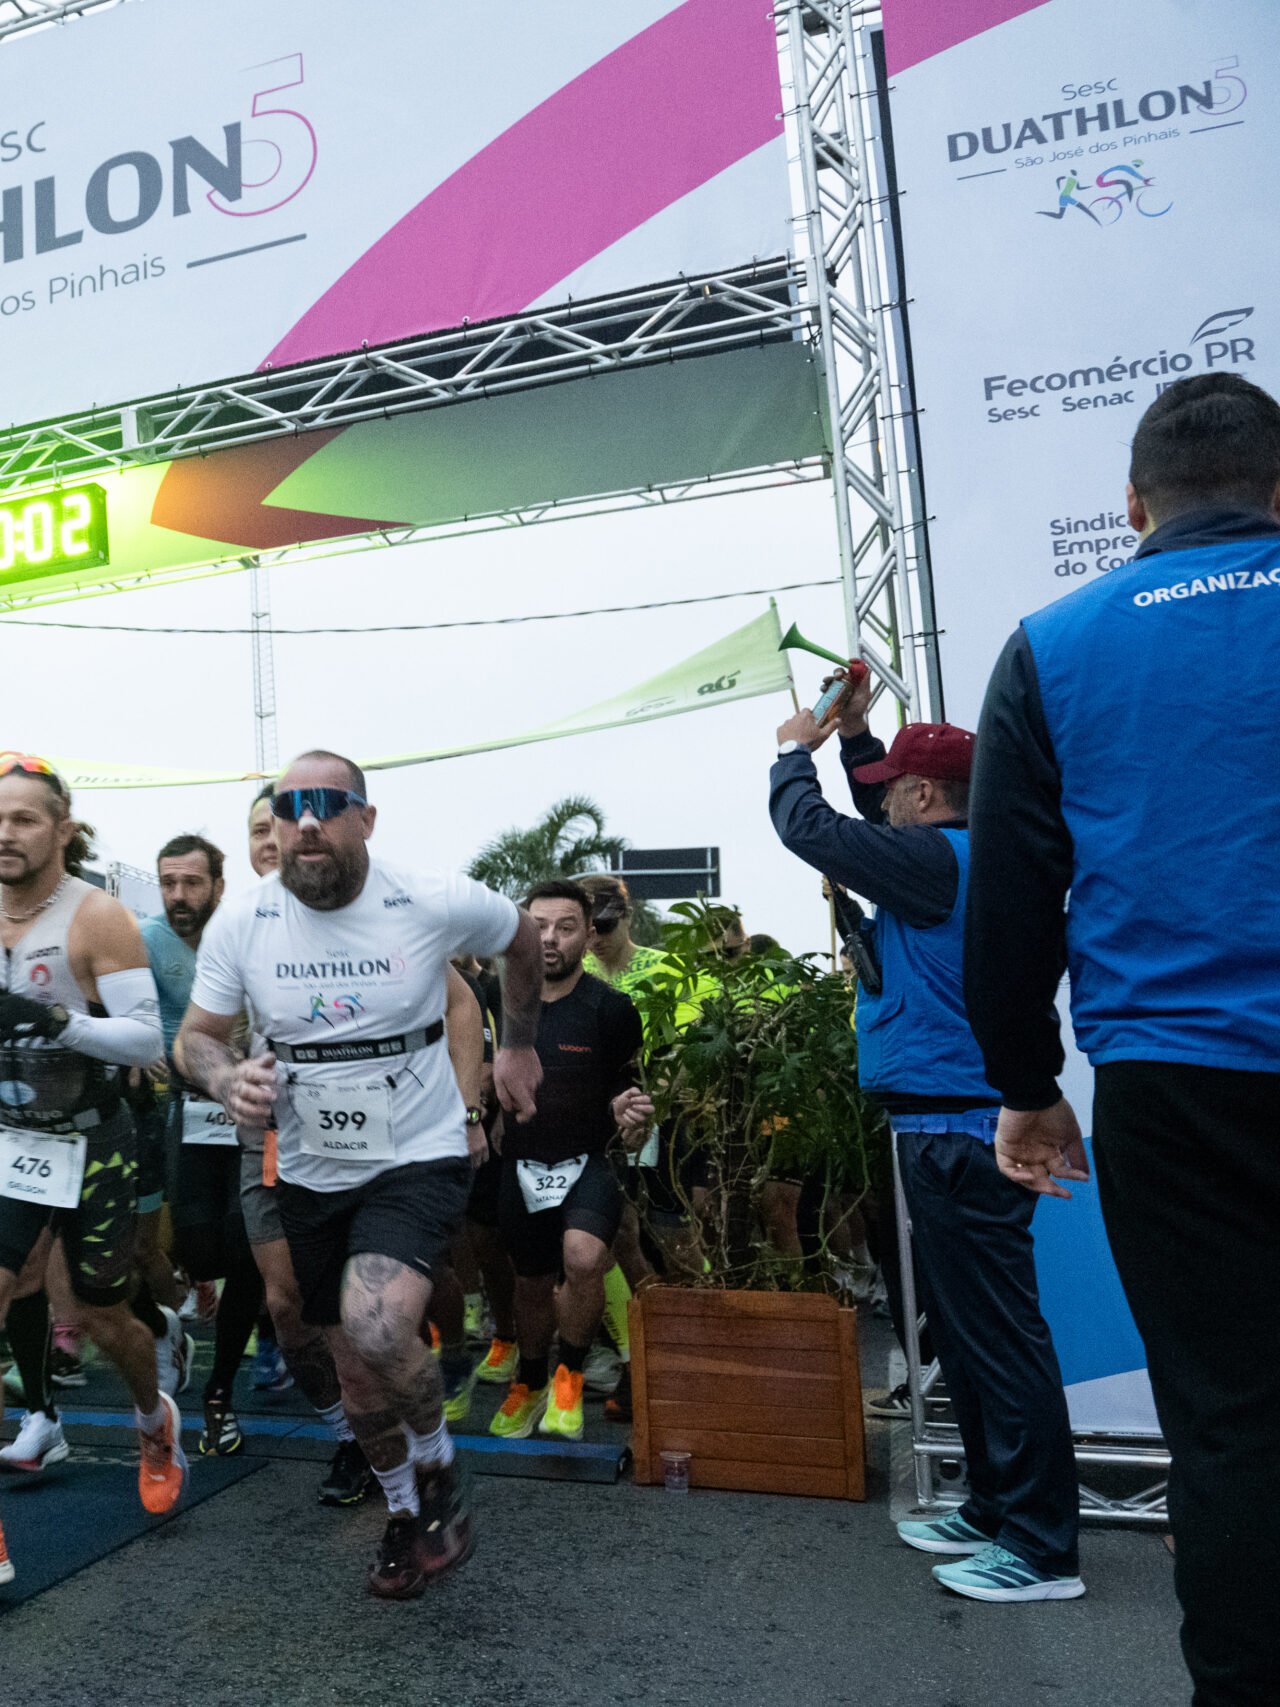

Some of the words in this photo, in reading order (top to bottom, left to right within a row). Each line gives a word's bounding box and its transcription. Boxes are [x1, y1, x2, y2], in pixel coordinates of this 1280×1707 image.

[1061, 78, 1118, 101] Sesc
[947, 80, 1214, 162] DUATHLON
[1015, 155, 1044, 170] São
[1051, 145, 1084, 163] José
[1088, 135, 1118, 154] dos
[1123, 127, 1180, 148] Pinhais
[49, 253, 166, 304] Pinhais
[984, 350, 1193, 401] Fecomércio
[1205, 337, 1256, 367] PR
[988, 404, 1040, 423] Sesc
[1062, 390, 1134, 412] Senac
[1050, 511, 1133, 536] Sindic
[1052, 533, 1139, 556] Empre
[1054, 559, 1087, 577] do
[276, 958, 391, 979] DUATHLON
[322, 1045, 374, 1057] DUATHLON
[319, 1110, 367, 1131] 399
[323, 1141, 368, 1151] ALDACIR
[11, 1156, 51, 1178] 476
[535, 1175, 567, 1191] 322
